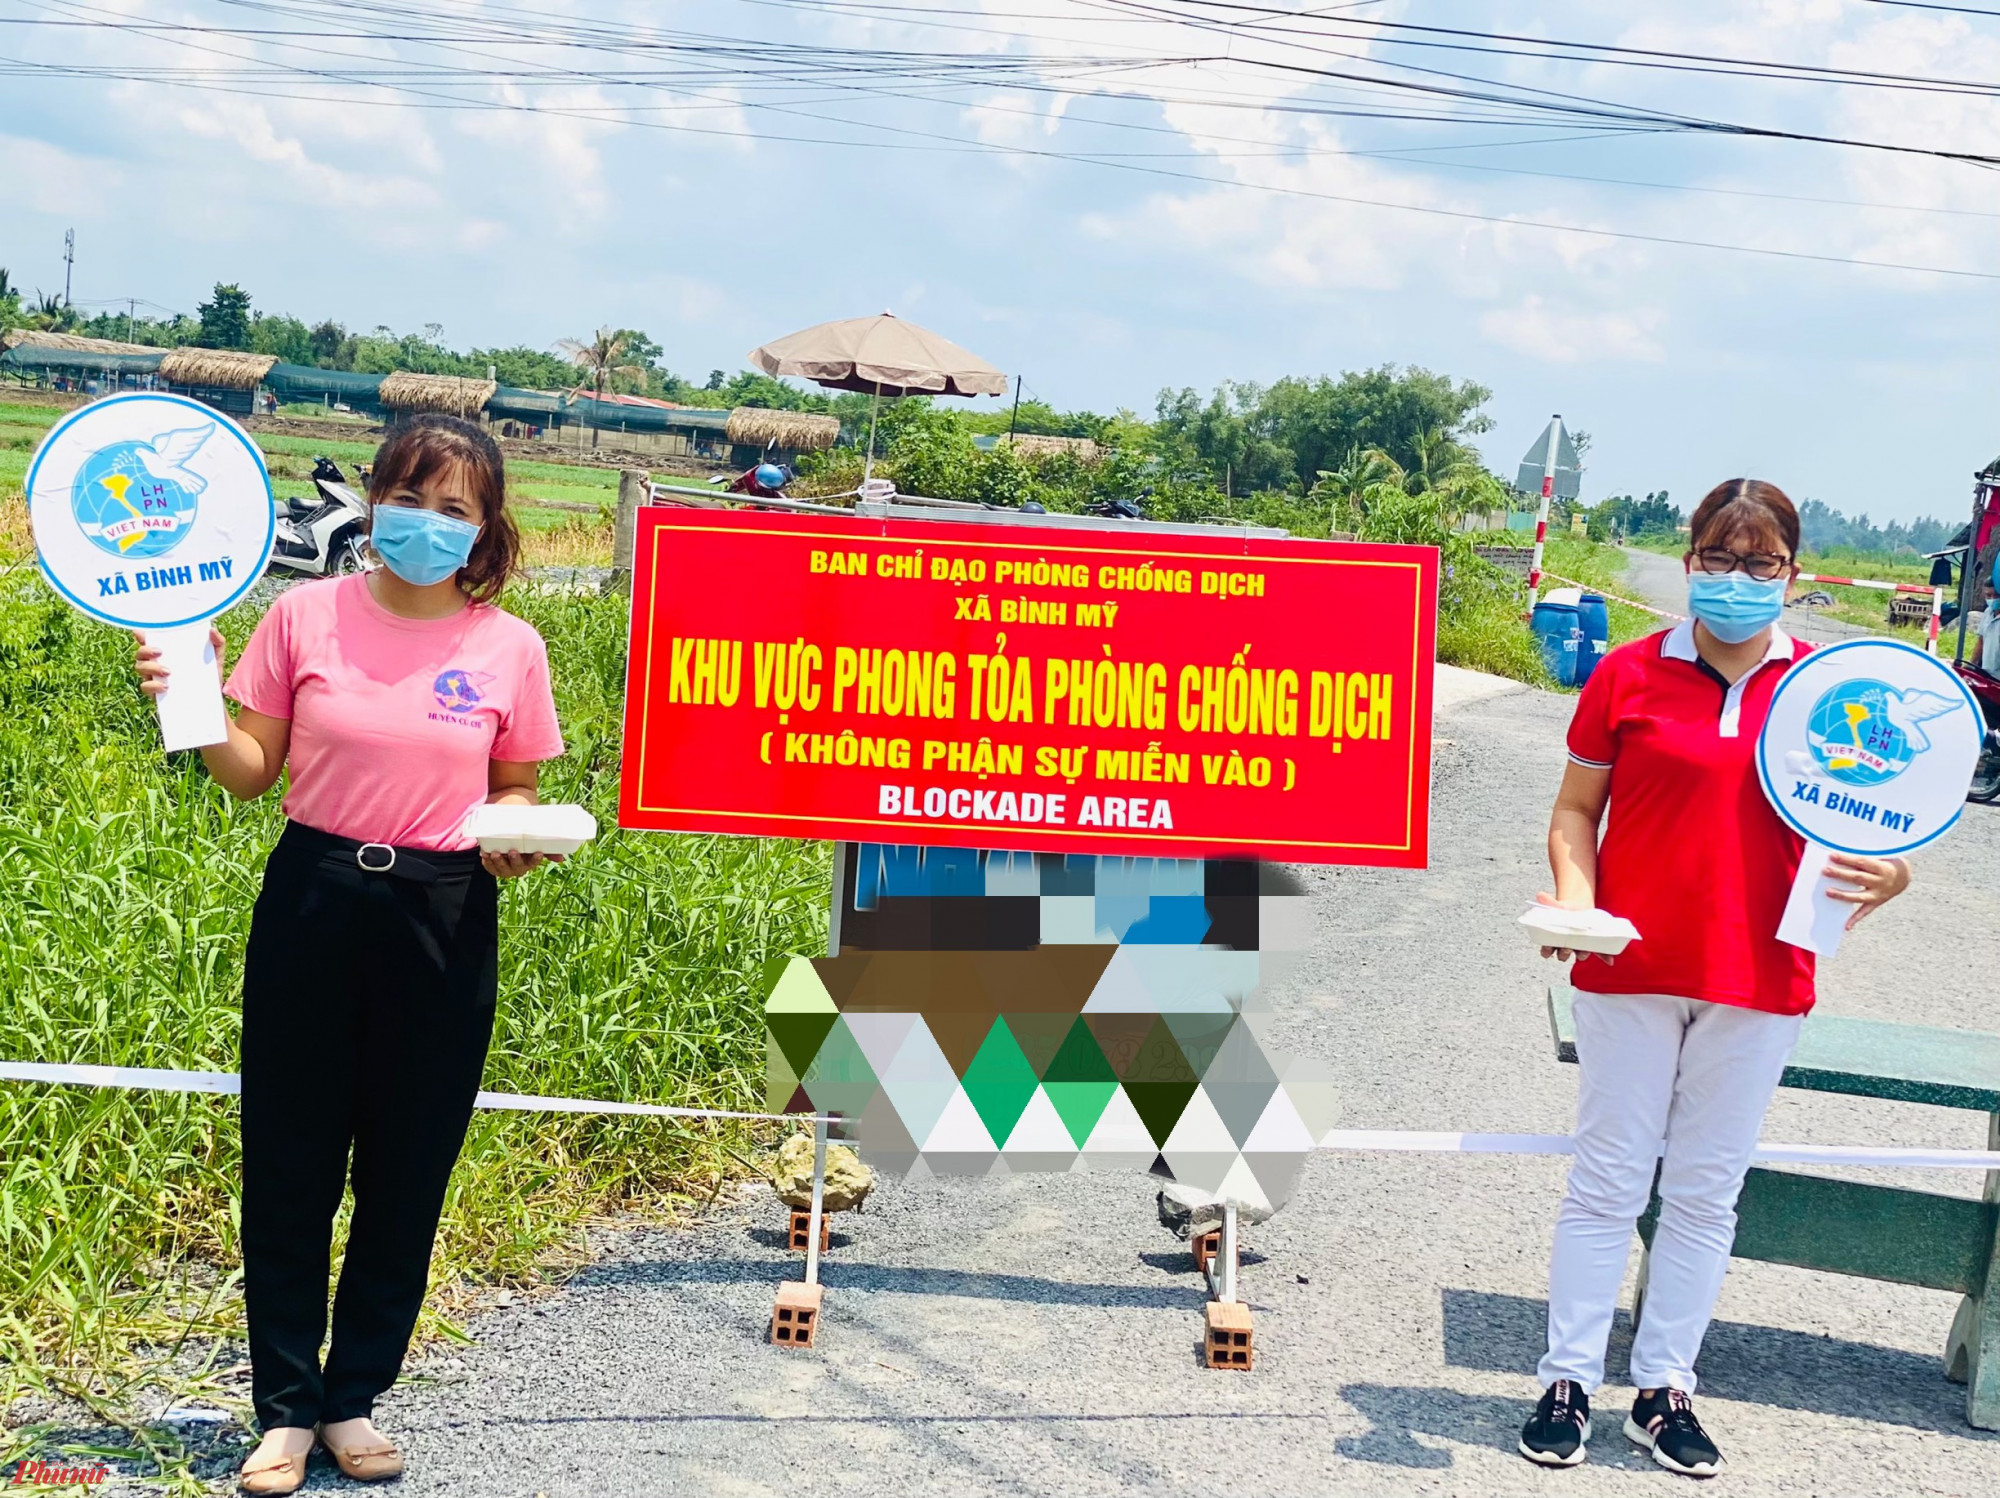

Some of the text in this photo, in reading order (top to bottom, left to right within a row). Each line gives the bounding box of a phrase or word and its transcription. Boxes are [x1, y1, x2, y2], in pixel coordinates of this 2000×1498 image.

[106, 518, 172, 537] VIET NAM
[97, 556, 233, 597] XÃ BÌNH MỸ
[810, 549, 1265, 600] BAN CHỈ ĐẠO PHÒNG CHỐNG DỊCH
[954, 594, 1119, 628] XÃ BÌNH MỸ
[669, 632, 1393, 754] KHU VỰC PHONG TỎA PHÒNG CHỐNG DỊCH
[784, 729, 911, 770] KHÔNG
[922, 737, 1023, 780] PHẬN
[1034, 745, 1088, 785] SỰ
[1095, 740, 1190, 784] MIỄN
[1201, 749, 1271, 787] VÀO
[1825, 745, 1883, 768] VIET NAM
[878, 785, 1174, 830] BLOCKADE AREA
[1791, 781, 1915, 833] XÃ BÌNH MỸ
